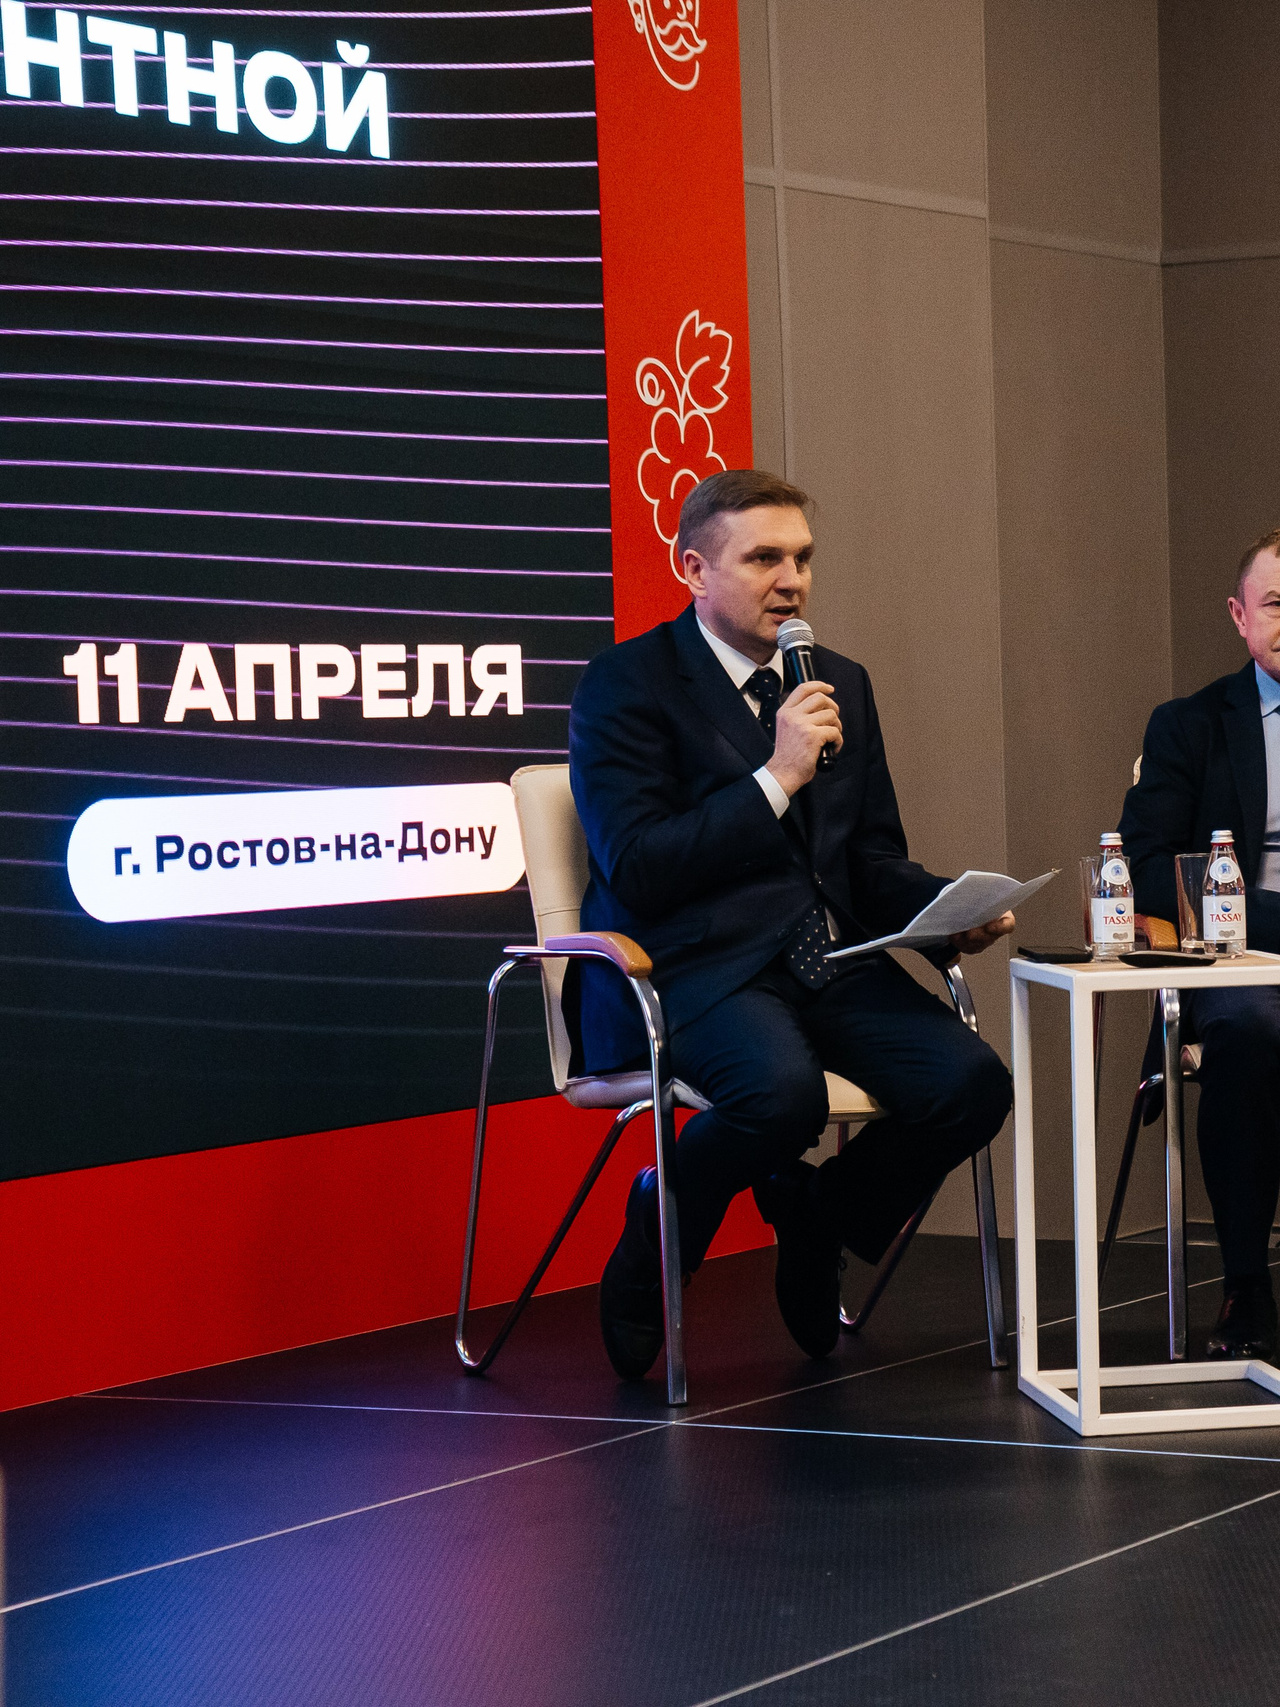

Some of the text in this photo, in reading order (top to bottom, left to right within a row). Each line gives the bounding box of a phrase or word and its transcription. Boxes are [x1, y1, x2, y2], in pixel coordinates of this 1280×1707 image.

[0, 0, 390, 159] НТНОЙ
[63, 642, 524, 724] 11 АПРЕЛЯ
[114, 821, 497, 876] г. Ростов-на-Дону
[1209, 913, 1243, 923] TASSAY
